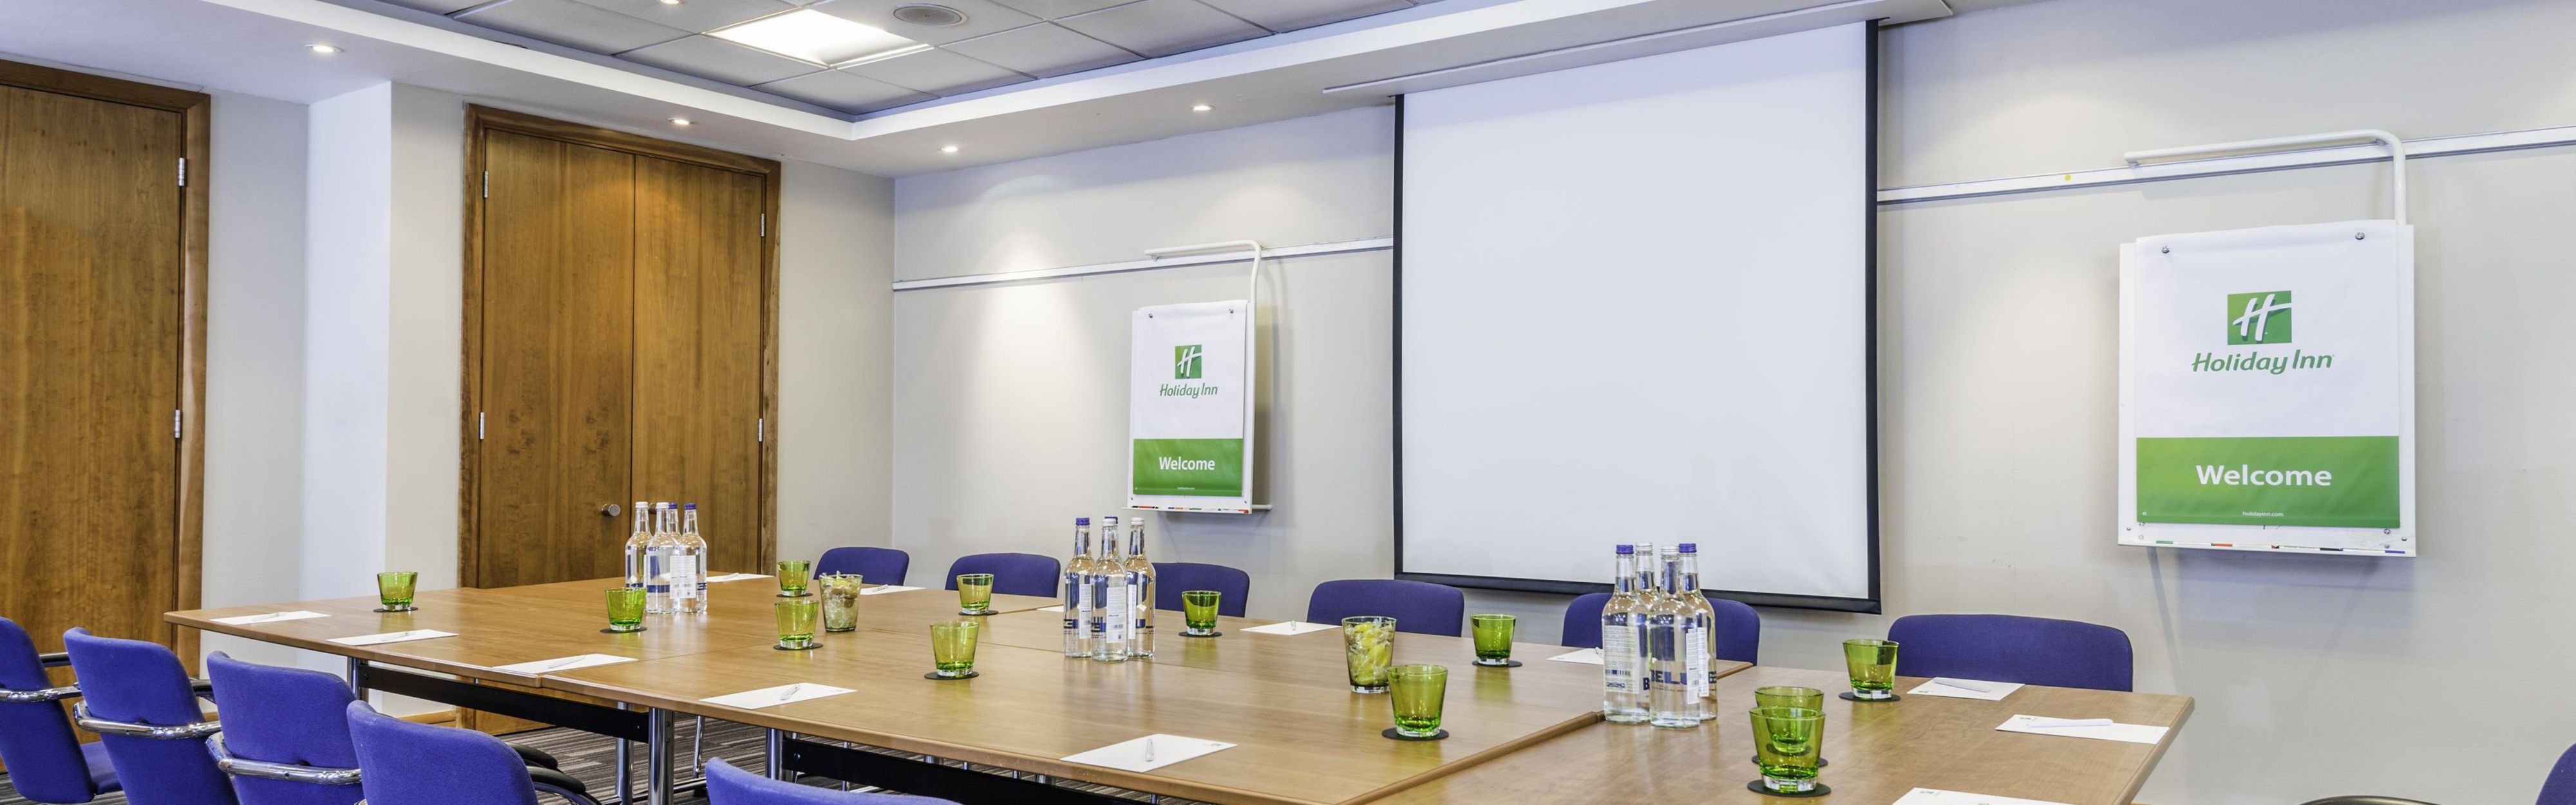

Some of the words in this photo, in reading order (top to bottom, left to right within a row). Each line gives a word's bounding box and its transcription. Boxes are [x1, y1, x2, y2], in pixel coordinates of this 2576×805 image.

[2191, 352, 2288, 375] Holiday
[2292, 350, 2333, 369] Inn
[1159, 383, 1200, 399] Holiday
[1200, 383, 1218, 395] Inn
[1159, 456, 1215, 470] Welcome
[2195, 464, 2332, 486] Welcome
